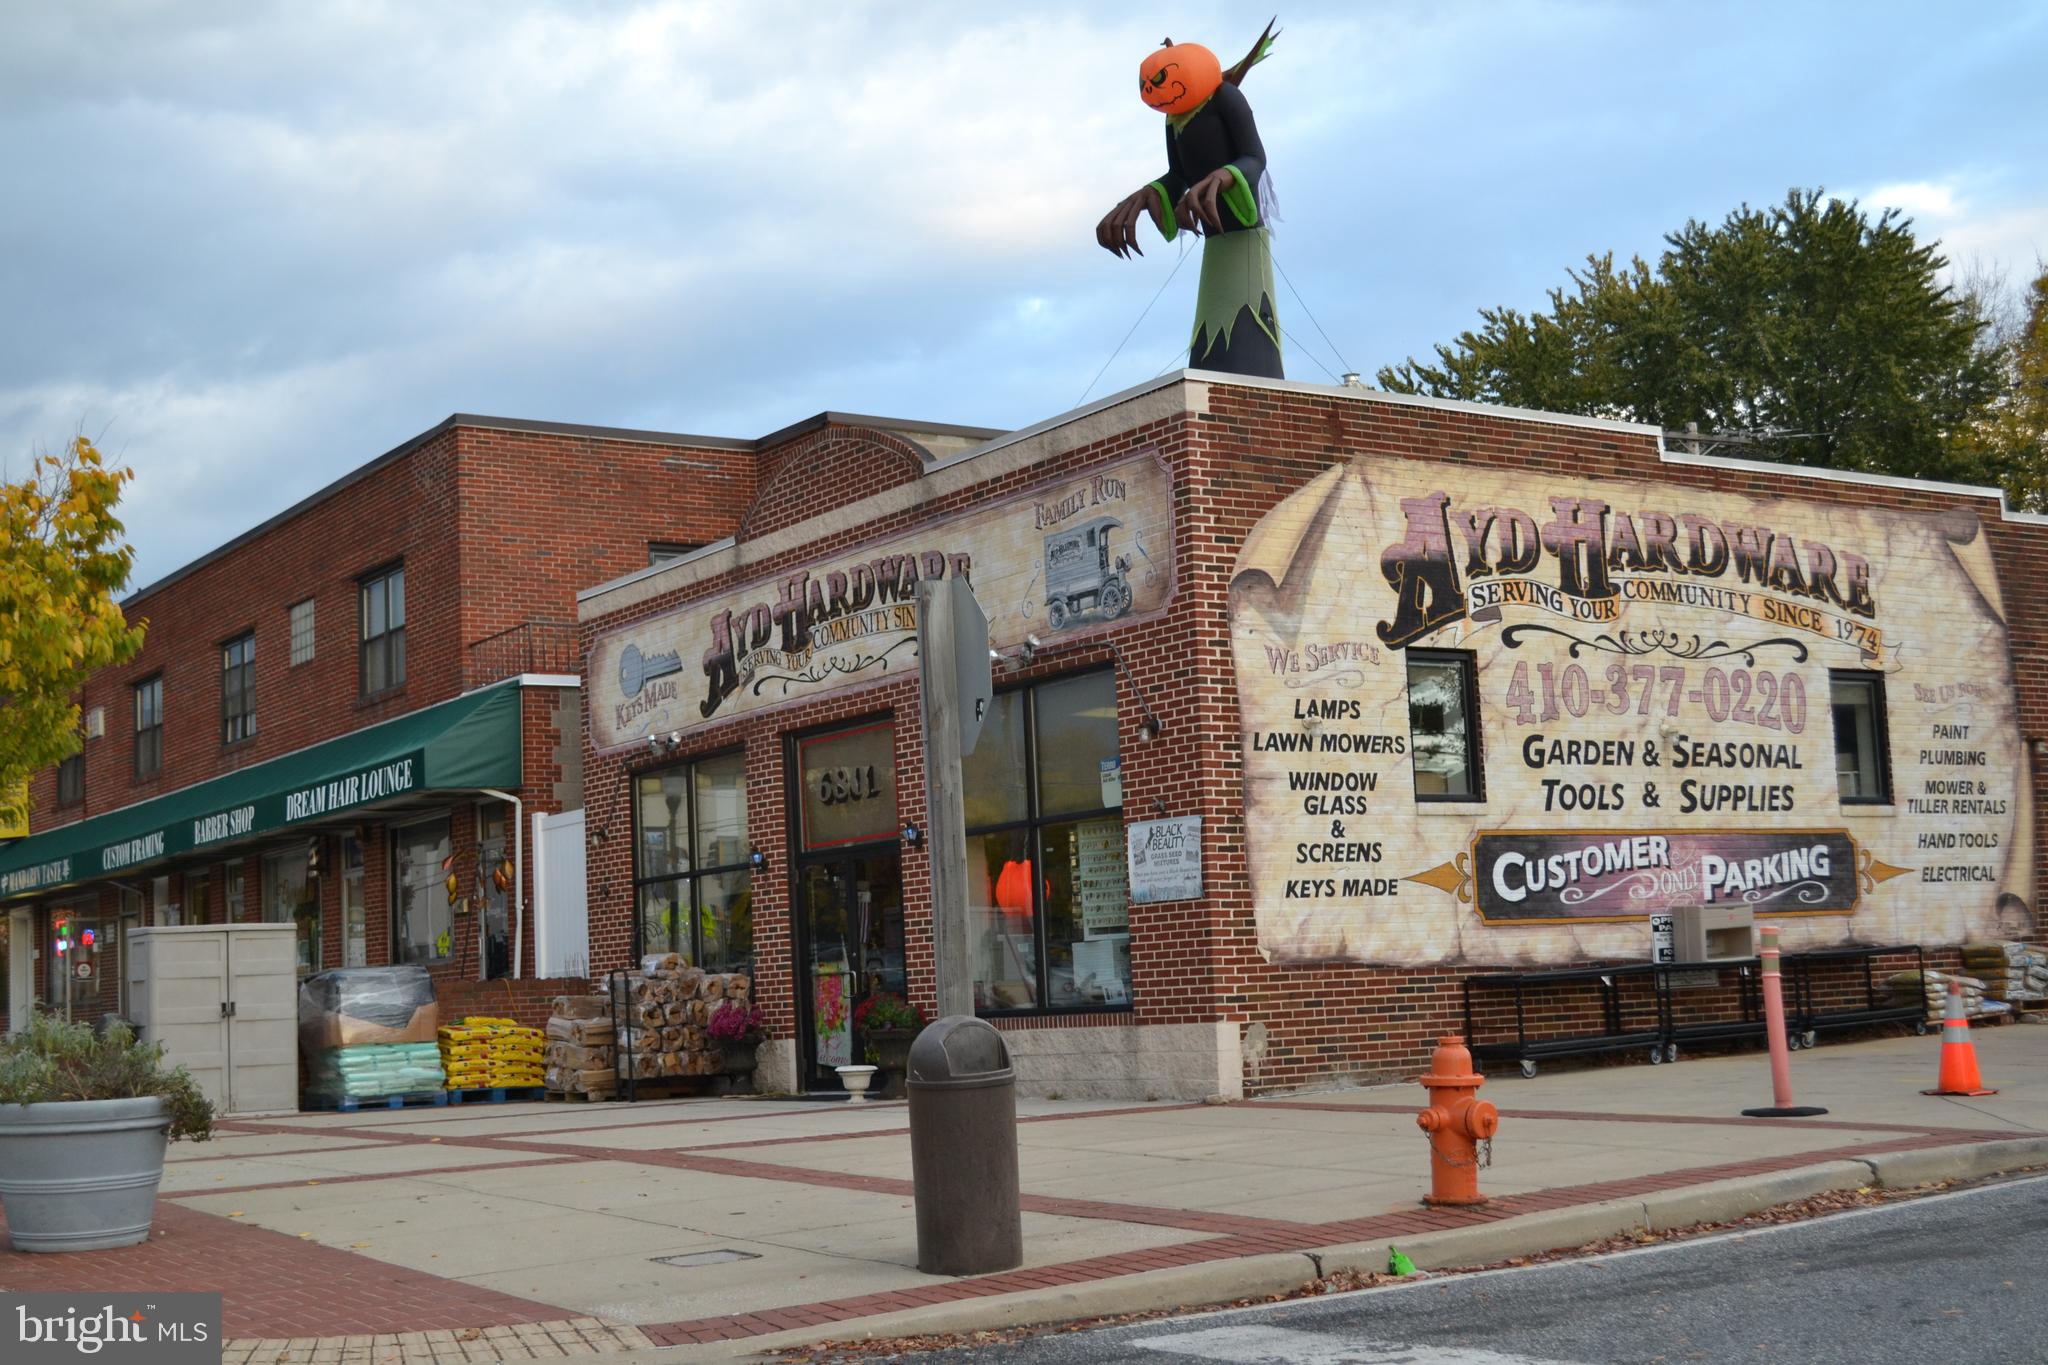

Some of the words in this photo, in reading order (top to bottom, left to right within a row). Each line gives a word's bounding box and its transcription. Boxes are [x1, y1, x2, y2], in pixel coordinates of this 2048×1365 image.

[1033, 488, 1086, 530] FAMILY
[1089, 475, 1127, 507] RUN
[1376, 489, 1541, 650] AYD
[1541, 496, 1876, 620] HARDWARE
[1471, 579, 1563, 613] SERVING
[1572, 599, 1617, 621] YOUR
[1623, 580, 1751, 614] COMMUNITY
[1764, 600, 1823, 632] SINCE
[1835, 618, 1878, 652] 1974
[742, 649, 782, 678] SERVING
[786, 649, 812, 671] YOUR
[812, 606, 890, 649] COMMUNITY
[893, 605, 918, 629] SIN
[700, 603, 773, 719] AYD
[1263, 643, 1300, 675] WE
[1304, 641, 1381, 672] SERVICE
[615, 697, 643, 731] KEYS
[643, 681, 678, 713] MADE
[1506, 660, 1807, 734] 410-377-0220
[1293, 698, 1361, 720] LAMPS
[1253, 732, 1313, 752] LAWN
[1319, 733, 1405, 755] MOWERS
[1932, 724, 1969, 740] PAINT
[1522, 734, 1635, 769] GARDEN
[1642, 739, 1661, 767] &
[1672, 734, 1802, 770] SEASONAL
[1919, 749, 1986, 766] PLUMBING
[286, 785, 327, 822] DREAM
[328, 775, 359, 811] HAIR
[360, 758, 413, 801] LOUNGE
[1288, 771, 1378, 792] WINDOW
[1925, 780, 1974, 795] MOWER
[1977, 781, 1987, 796] &
[1303, 795, 1368, 816] GLASS
[1541, 778, 1625, 812] TOOLS
[1642, 781, 1661, 808] &
[1680, 778, 1795, 814] SUPPLIES
[1906, 798, 1949, 814] TILLER
[1952, 799, 2006, 815] RENTALS
[194, 811, 229, 845] BARBER
[230, 805, 255, 837] SHOP
[1155, 823, 1183, 838] BLACK
[1330, 819, 1346, 839] &
[103, 841, 131, 871] CUSTOM
[131, 830, 165, 863] FRAMING
[1152, 836, 1187, 851] BEAUTY
[1918, 833, 1956, 849] HAND
[1959, 833, 1998, 849] TOOLS
[1296, 842, 1382, 864] SCREENS
[1492, 835, 1673, 902] CUSTOMER
[1660, 861, 1700, 895] ONLY
[1700, 844, 1831, 903] PARKING
[1921, 865, 1996, 883] ELECTRICAL
[1285, 878, 1336, 899] KEYS
[1341, 878, 1399, 897] MADE
